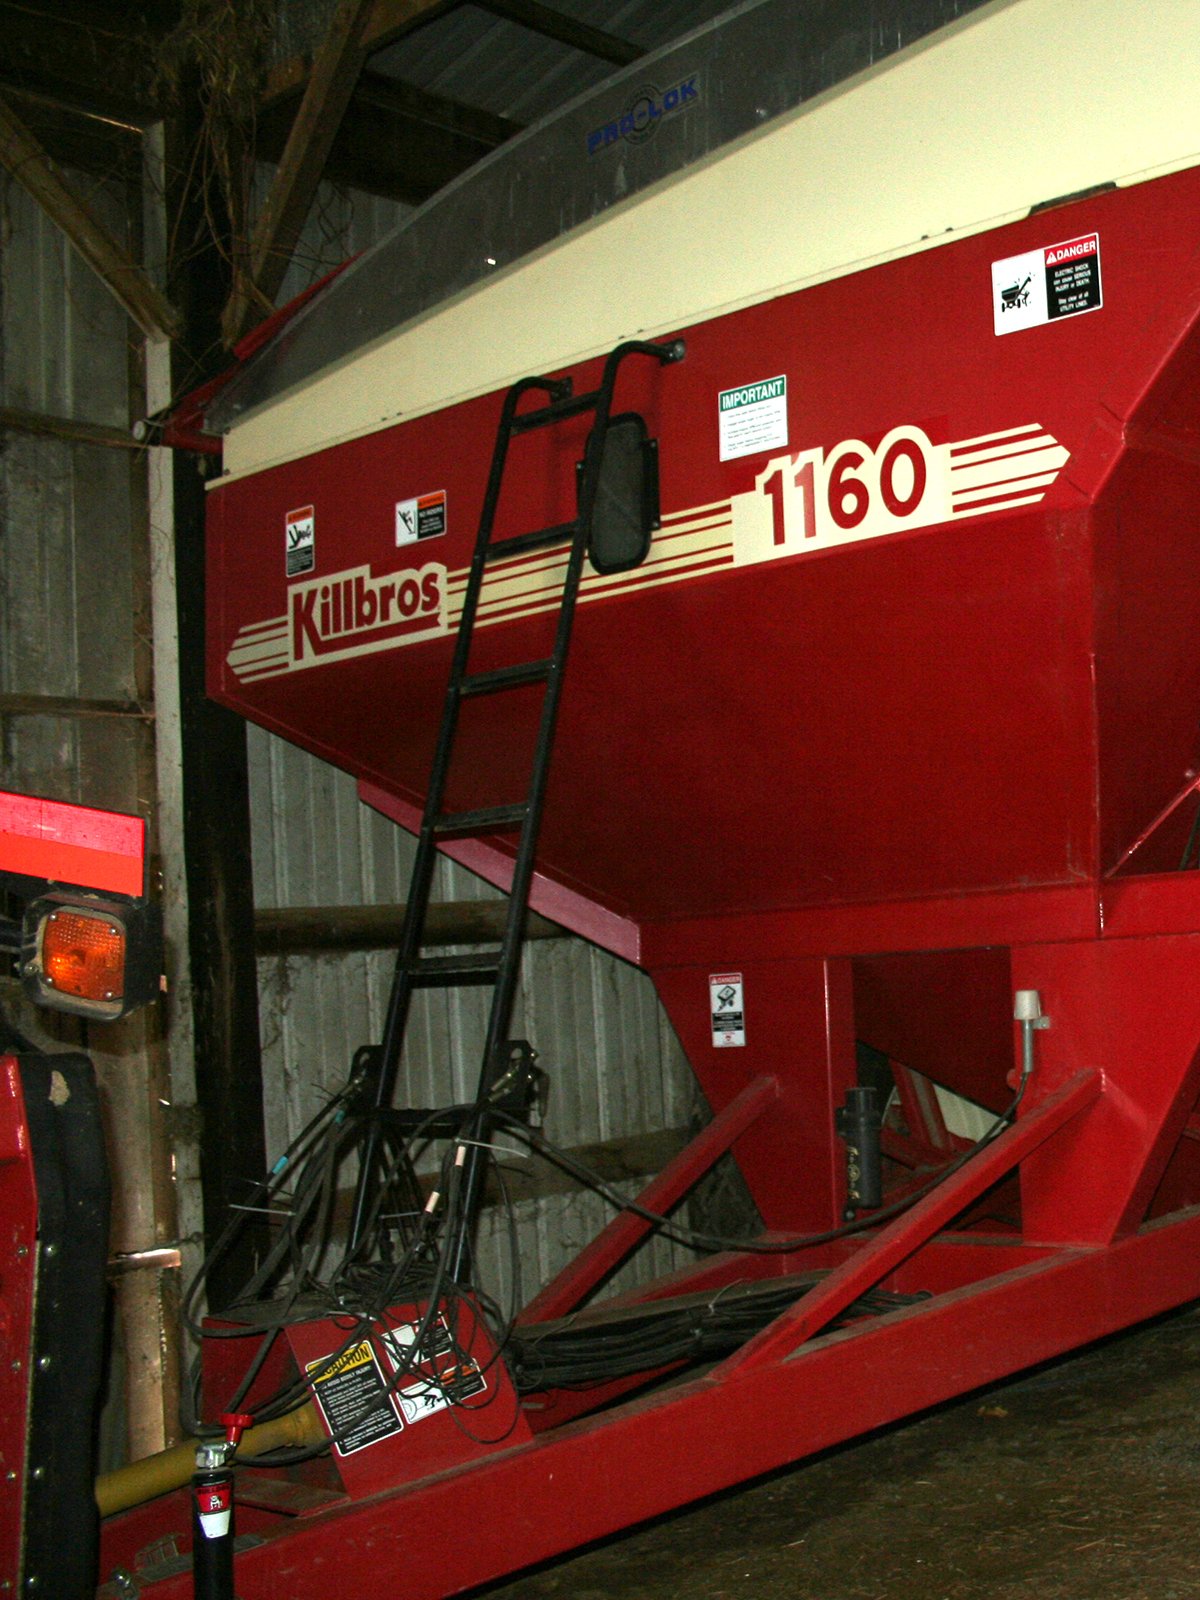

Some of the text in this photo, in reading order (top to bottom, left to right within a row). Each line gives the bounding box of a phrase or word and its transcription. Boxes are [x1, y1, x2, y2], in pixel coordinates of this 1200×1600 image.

[1056, 240, 1096, 260] DANGER
[722, 381, 783, 410] IMPORTANT
[763, 438, 926, 546] 1160
[293, 572, 442, 661] Killbros
